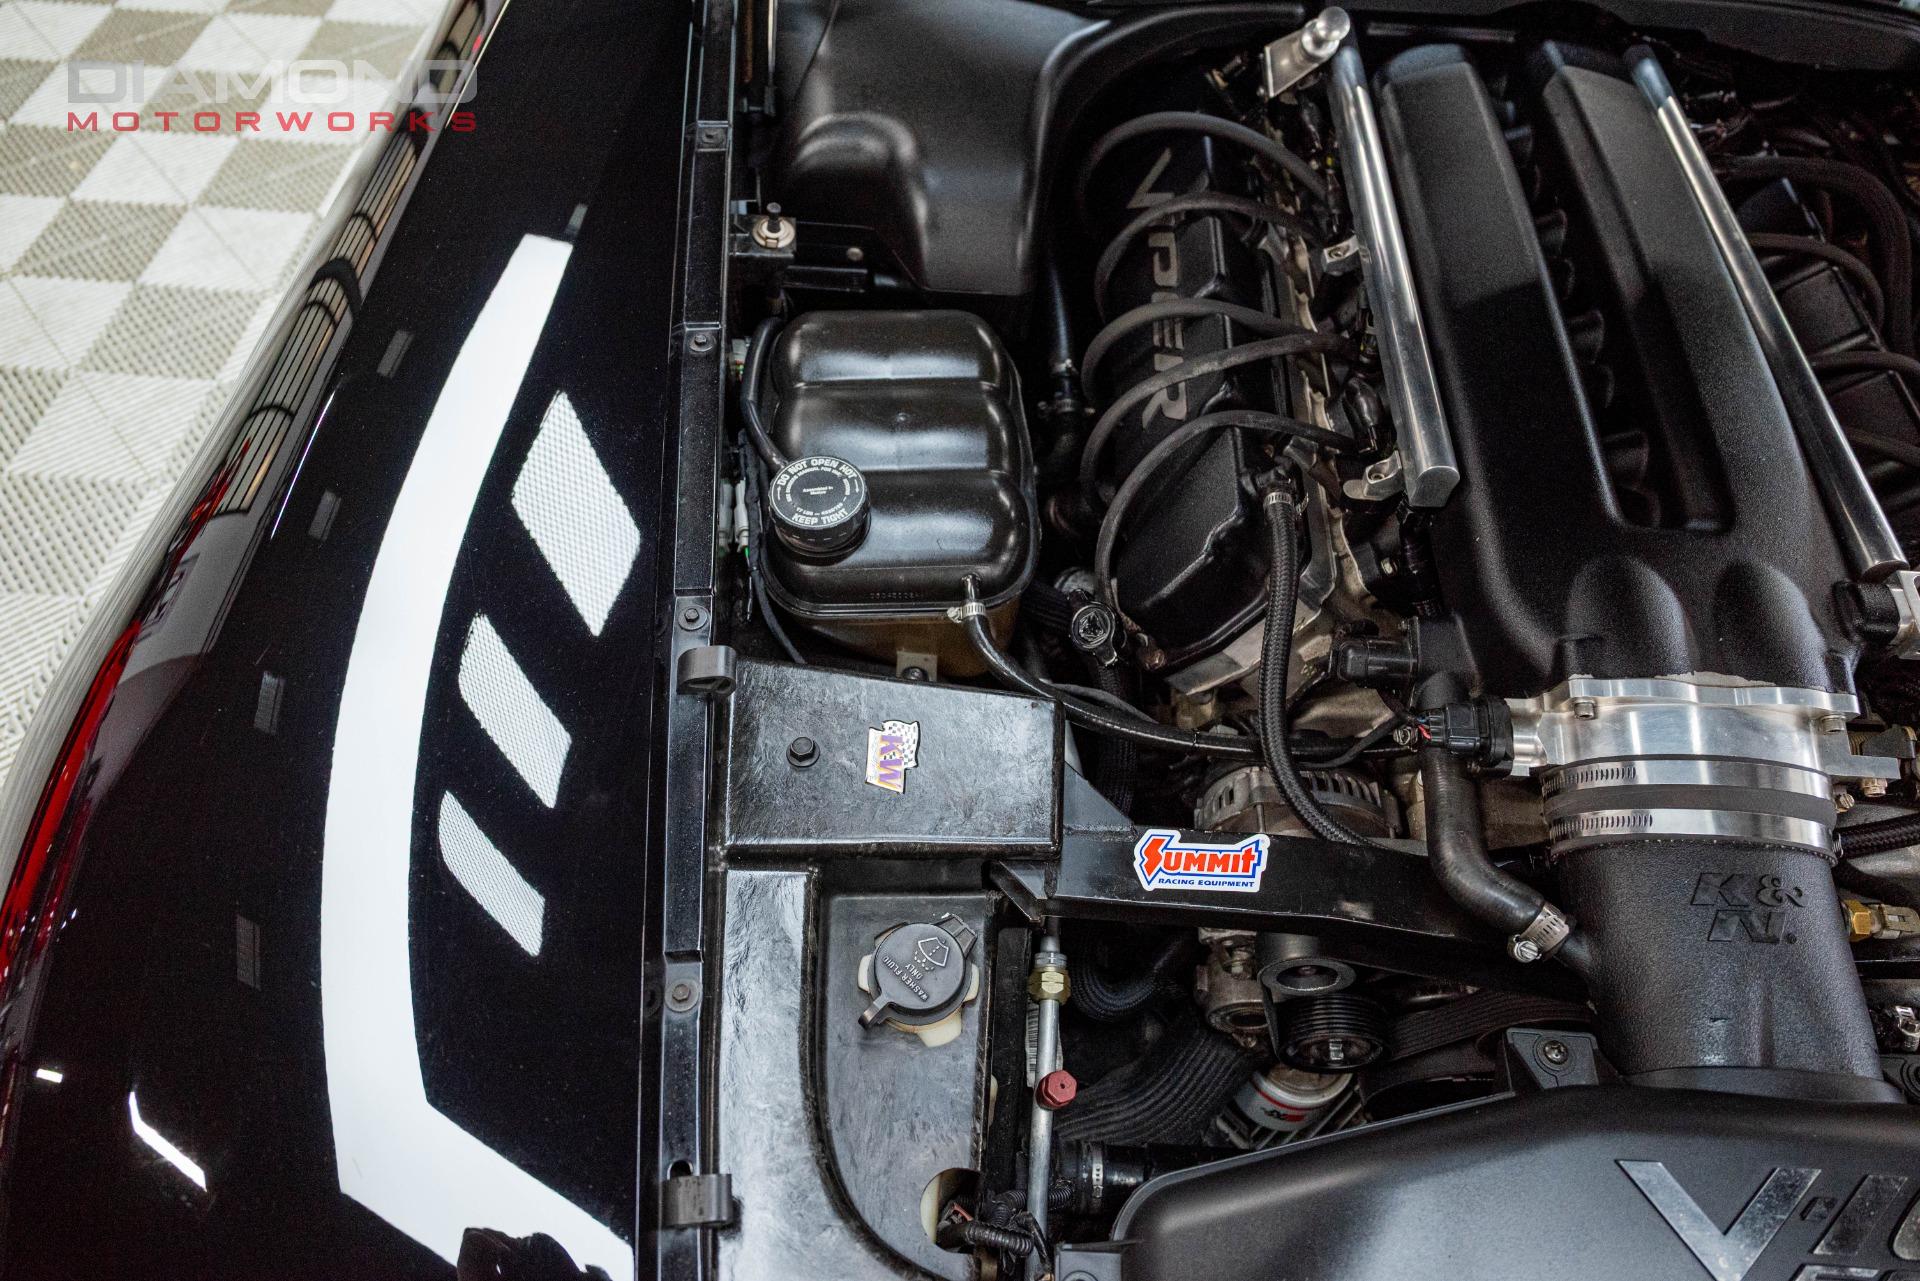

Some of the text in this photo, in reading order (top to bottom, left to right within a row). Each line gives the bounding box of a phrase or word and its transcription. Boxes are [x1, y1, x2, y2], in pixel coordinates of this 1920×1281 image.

[776, 458, 858, 486] DO NOT OPEN HOT
[791, 513, 819, 525] KEEP
[820, 508, 849, 524] TIGHT
[1158, 878, 1255, 888] RACING EQUIPMENT
[882, 955, 928, 1000] WASHER FLUID
[905, 963, 923, 980] ONLY
